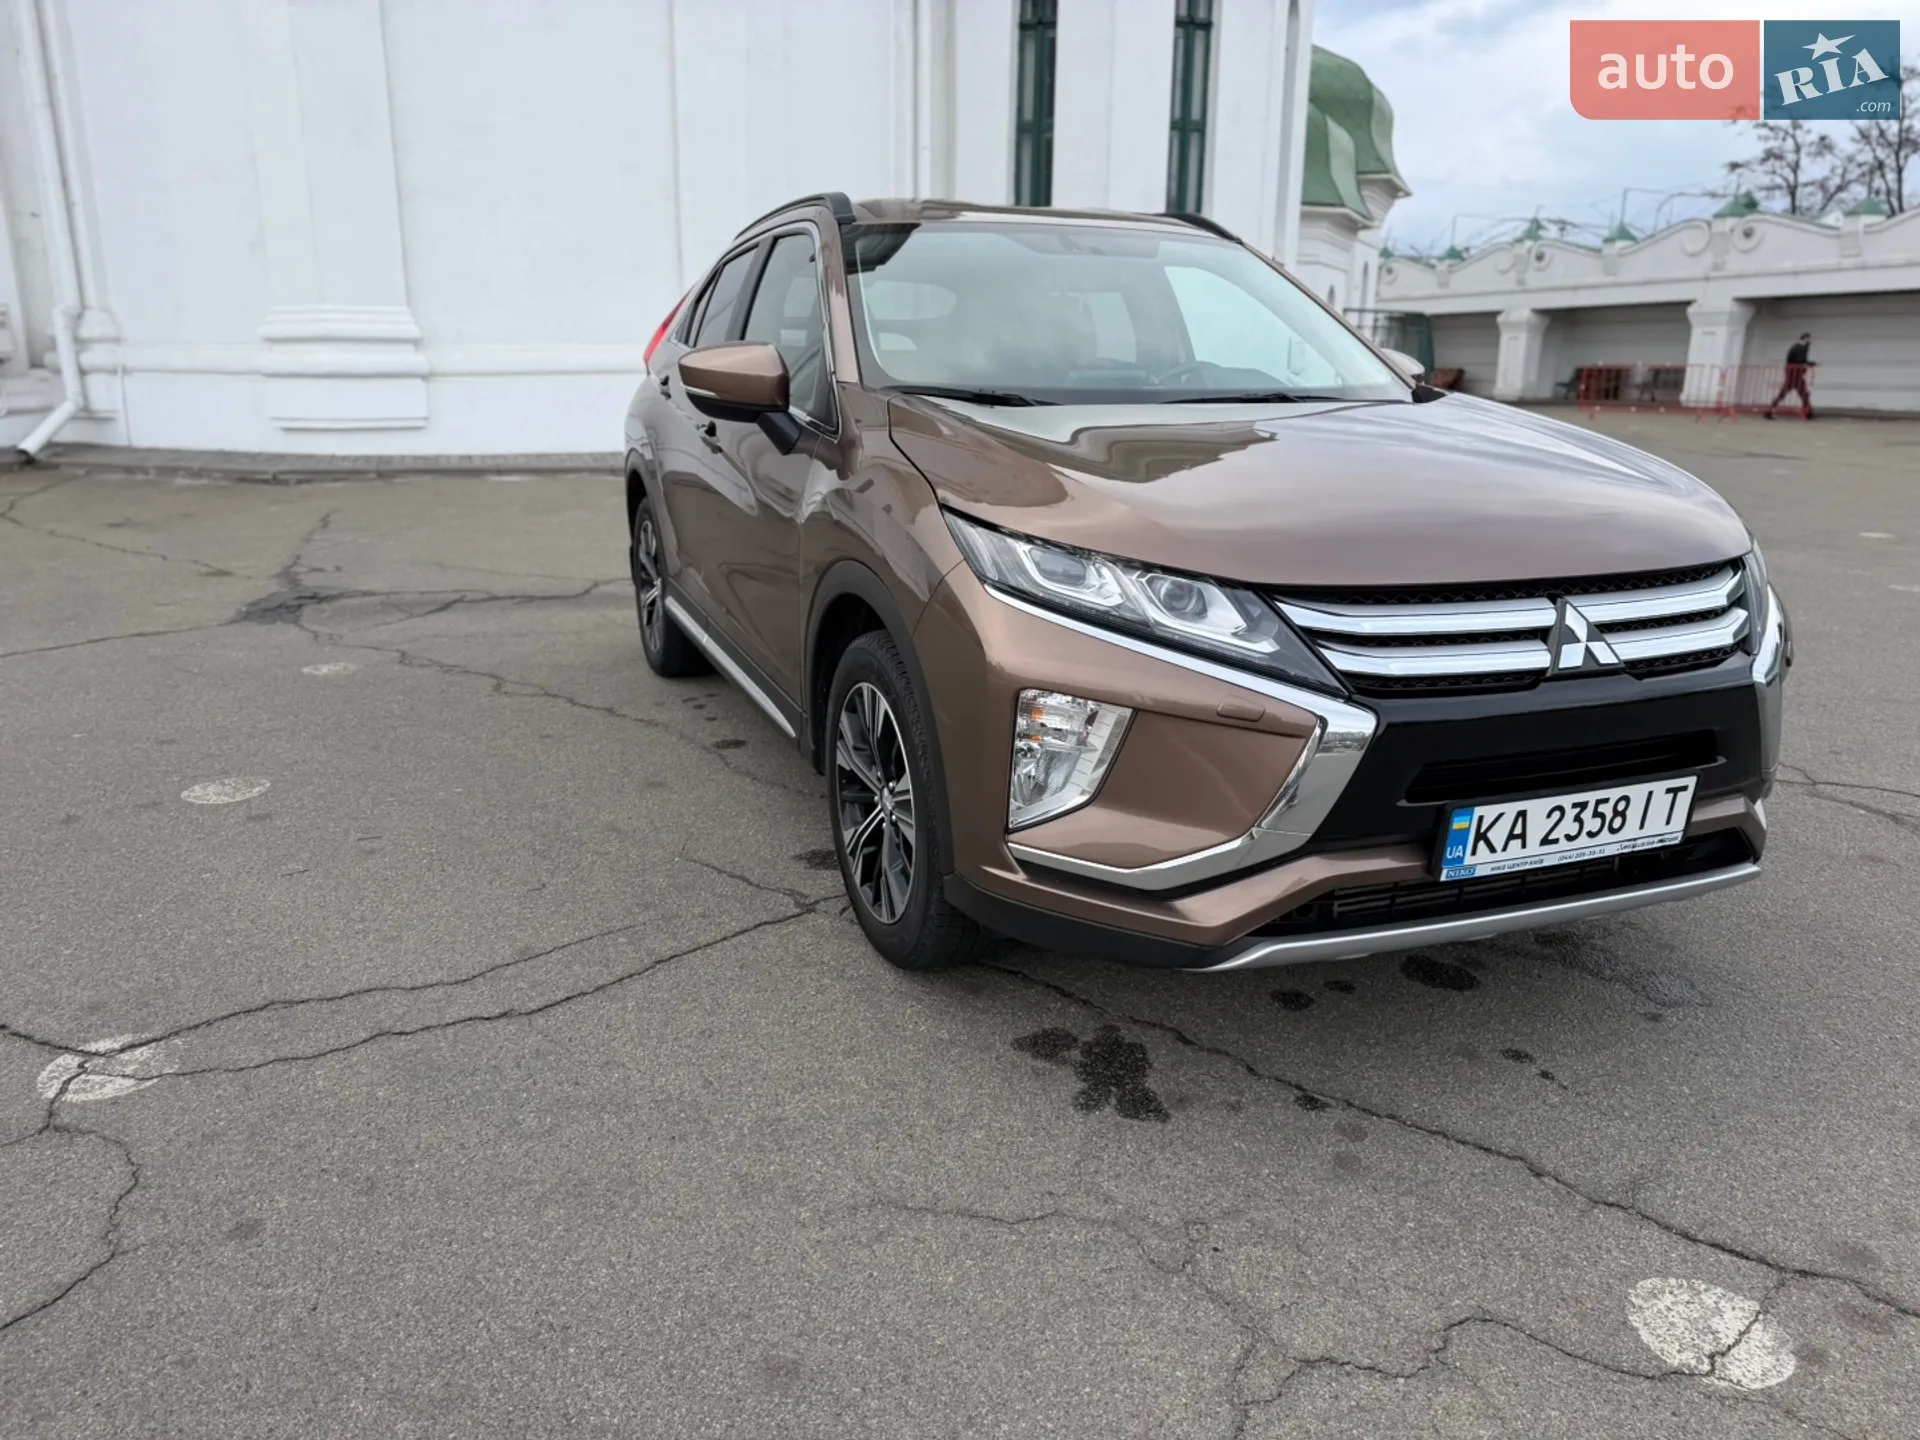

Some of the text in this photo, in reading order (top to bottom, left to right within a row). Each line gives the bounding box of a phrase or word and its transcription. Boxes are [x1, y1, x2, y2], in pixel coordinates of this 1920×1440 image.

[1470, 809, 1528, 857] KA
[1539, 795, 1631, 847] 2358
[1446, 845, 1464, 859] UA
